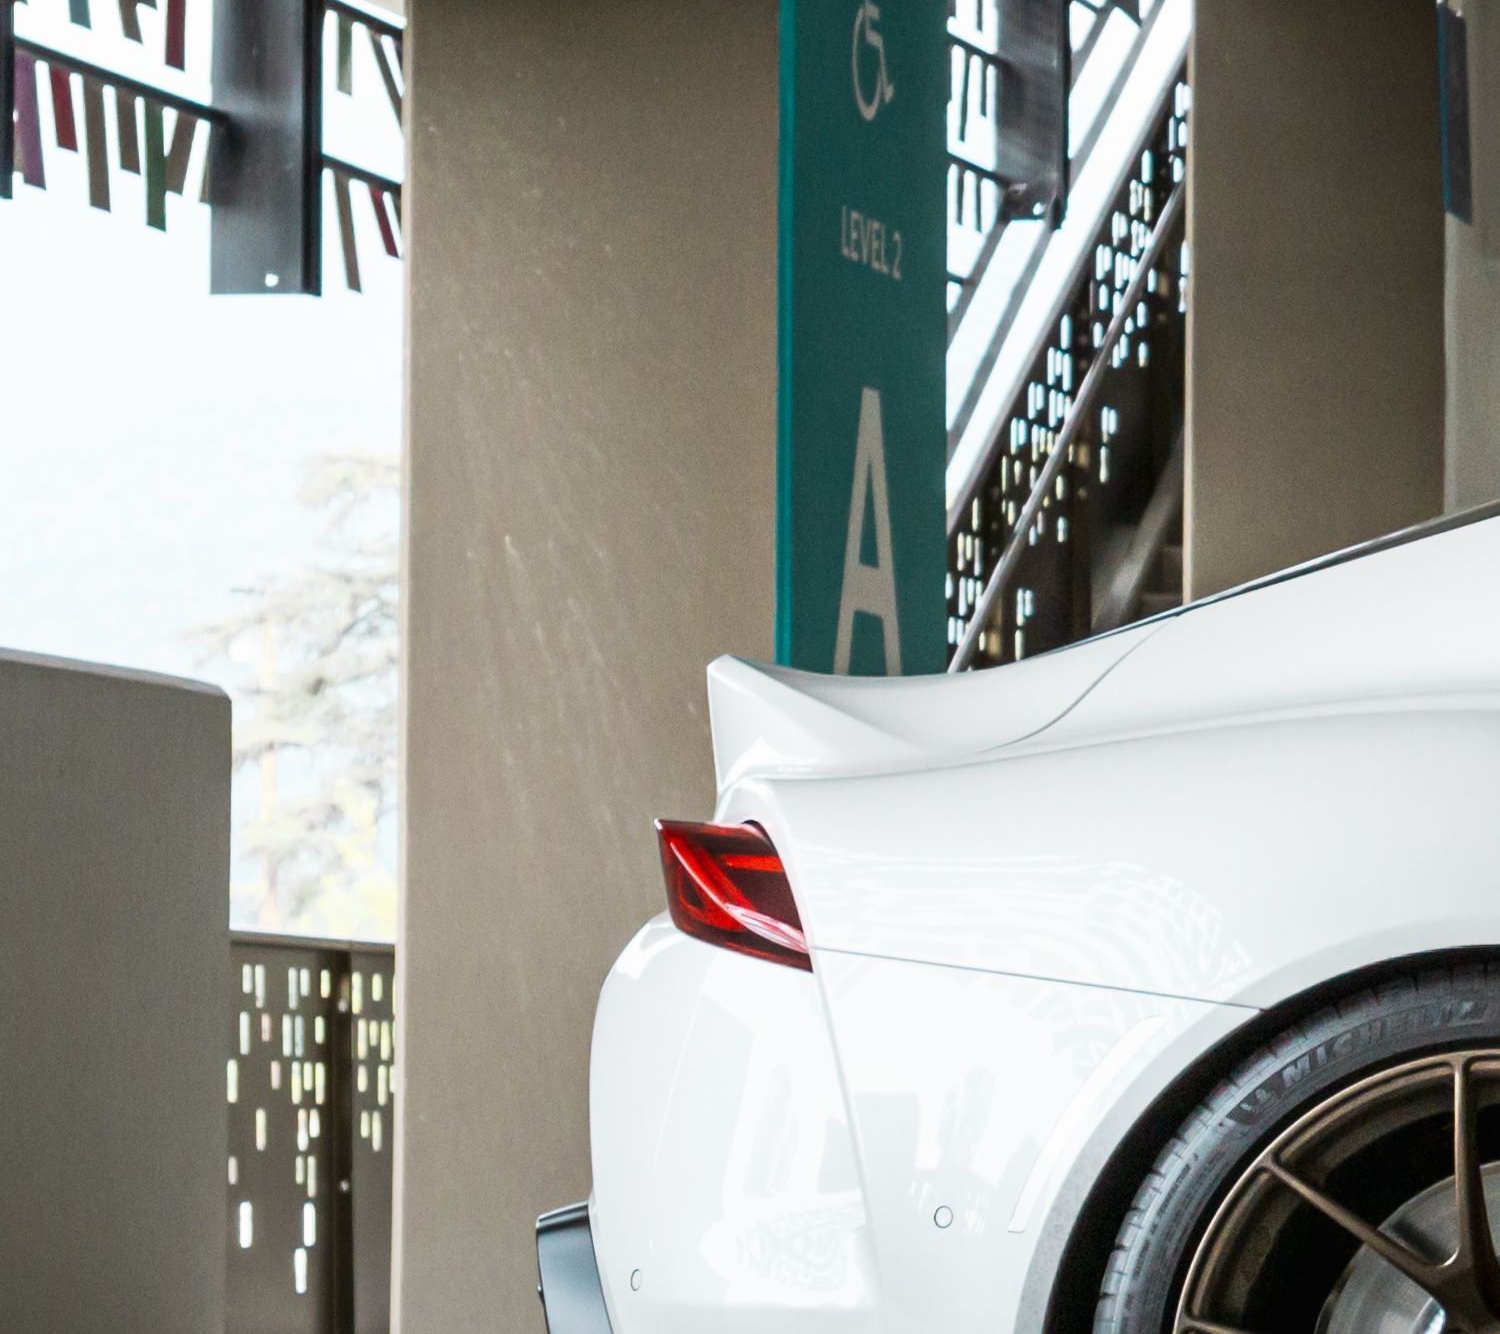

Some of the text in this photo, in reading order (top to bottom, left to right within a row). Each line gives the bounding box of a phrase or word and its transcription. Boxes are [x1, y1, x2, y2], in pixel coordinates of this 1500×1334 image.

[841, 204, 903, 282] LEVEL 2
[833, 387, 903, 677] A
